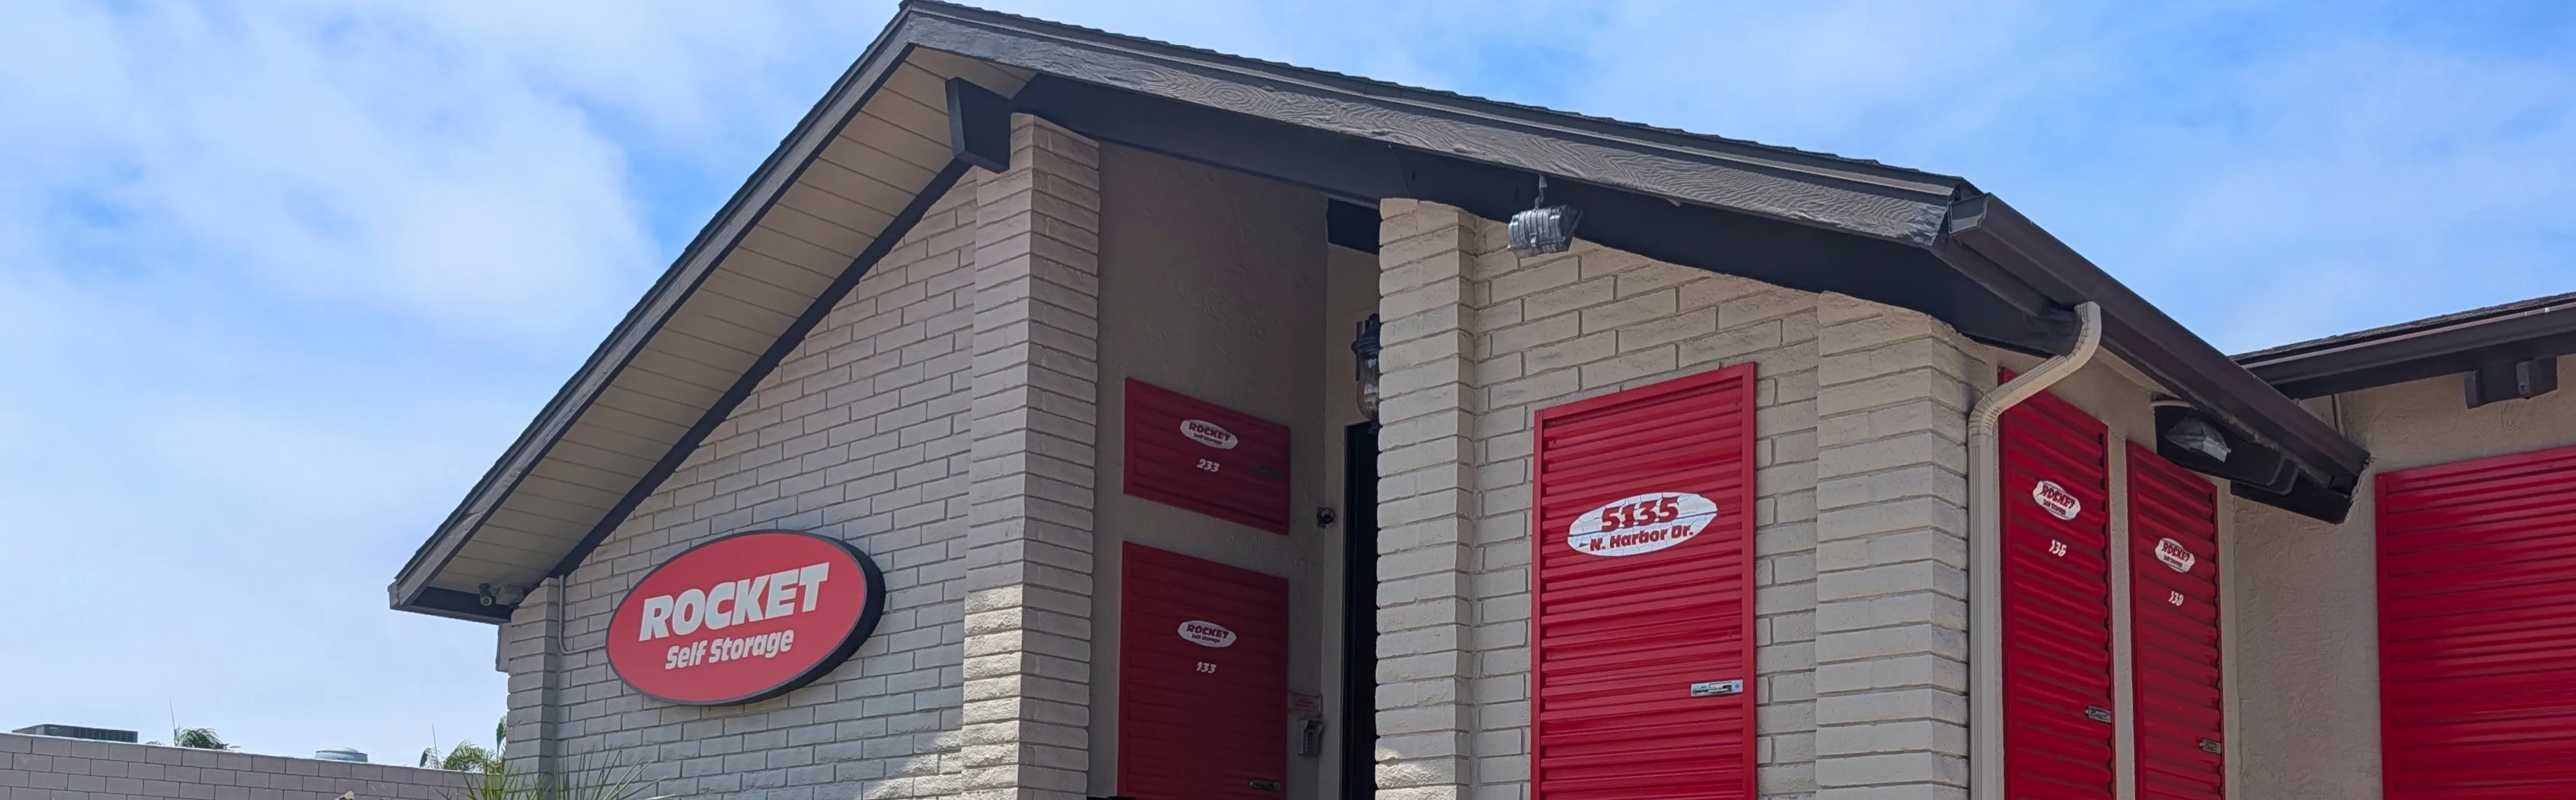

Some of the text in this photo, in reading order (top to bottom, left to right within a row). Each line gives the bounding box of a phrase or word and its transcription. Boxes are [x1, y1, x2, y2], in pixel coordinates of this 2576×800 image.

[1188, 422, 1231, 441] ROCKET
[1197, 458, 1220, 473] 233
[2039, 483, 2076, 509] ROCKET
[1602, 496, 1679, 532] 5135
[1590, 524, 1694, 551] N. Harbor Dr.
[2048, 539, 2067, 557] 136
[2161, 542, 2190, 563] ROCKET
[639, 562, 830, 642] ROCKET
[2168, 591, 2184, 607] 138
[1185, 623, 1229, 639] ROCKET
[665, 629, 795, 670] Self Storage
[1195, 661, 1217, 674] 133
